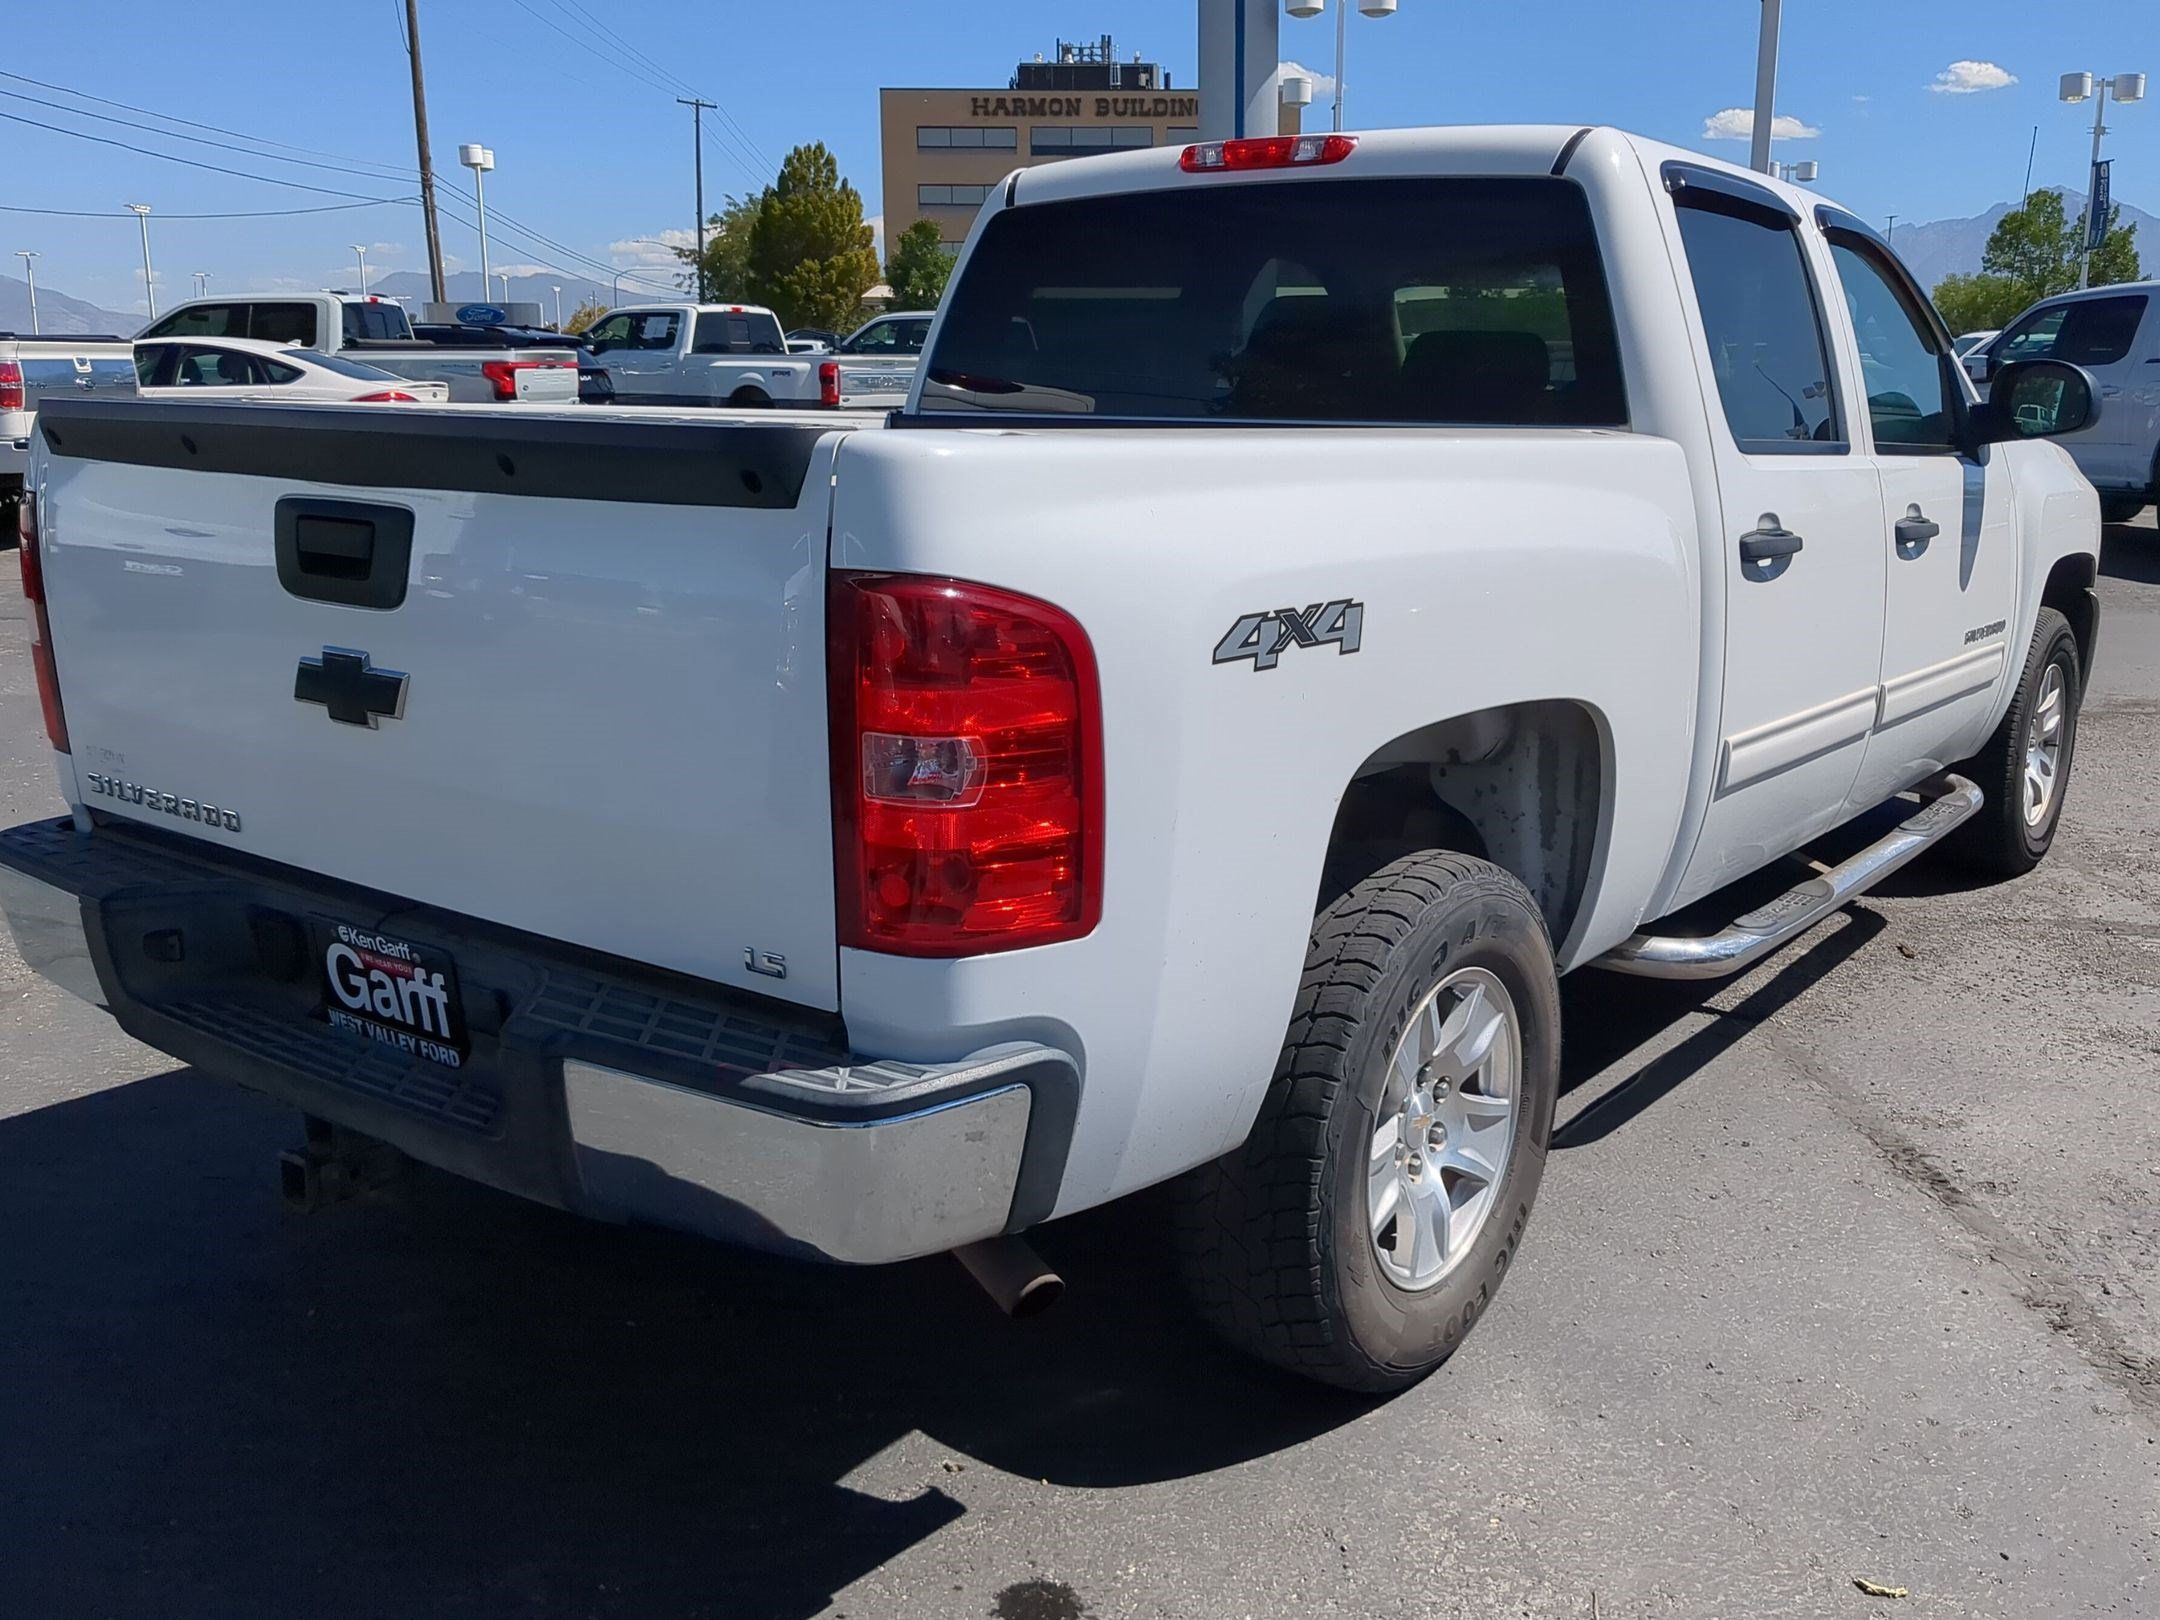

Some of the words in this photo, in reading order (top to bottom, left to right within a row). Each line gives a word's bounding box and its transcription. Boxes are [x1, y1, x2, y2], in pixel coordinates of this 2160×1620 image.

[971, 96, 1082, 117] HARMON
[1095, 97, 1198, 117] BUILDIN
[465, 308, 495, 322] Ford
[87, 771, 243, 833] SILVERADO
[326, 942, 451, 1039] Garff
[744, 945, 787, 980] LS
[327, 1008, 364, 1036] WEST
[365, 1022, 416, 1054] VALLEY
[420, 1040, 461, 1068] FORD
[1494, 1201, 1528, 1276] BIG
[1427, 1281, 1490, 1350] FOOT
